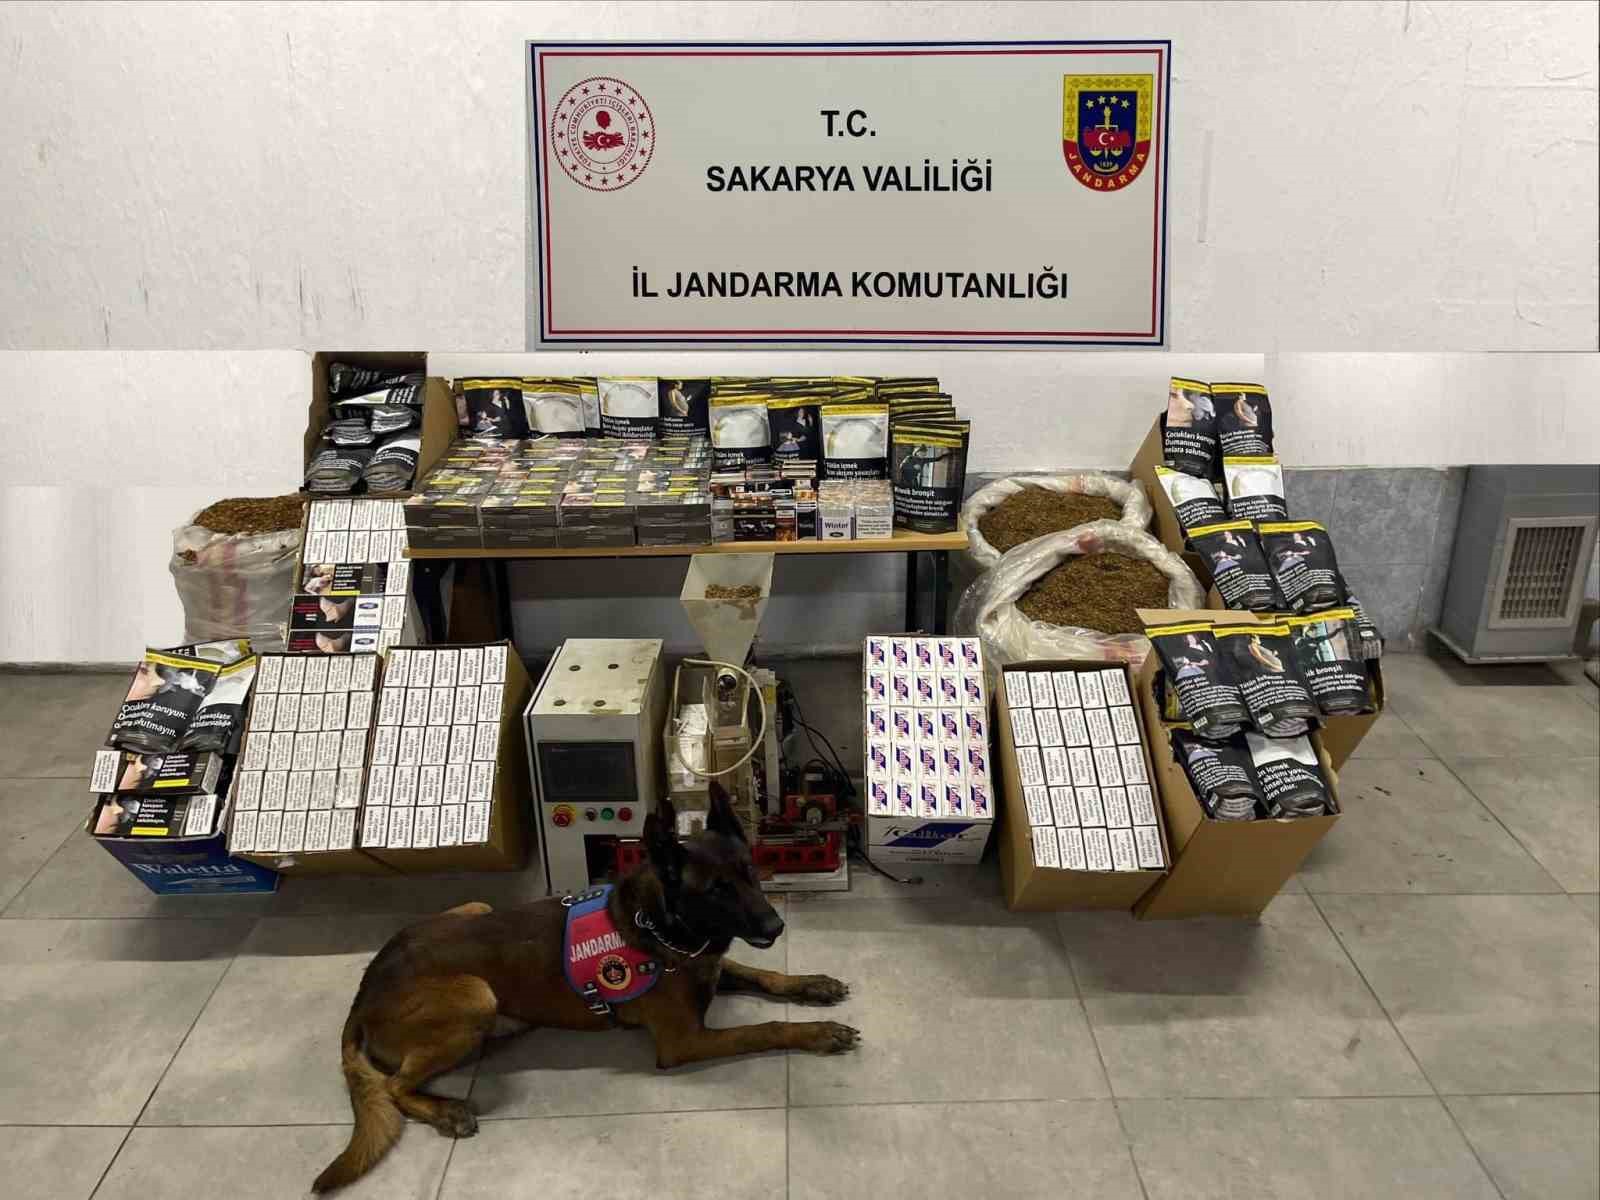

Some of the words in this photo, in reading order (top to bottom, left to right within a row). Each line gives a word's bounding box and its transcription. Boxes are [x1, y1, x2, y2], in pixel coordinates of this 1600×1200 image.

[821, 110, 875, 137] T.C.
[707, 166, 854, 191] SAKARYA
[863, 159, 991, 191] VALİLİĞİ
[1068, 152, 1146, 189] JANDARMA
[633, 266, 658, 297] İL
[667, 272, 843, 297] JANDARMA
[852, 266, 1067, 298] KOMUTANLIĞI
[824, 521, 849, 530] Winter
